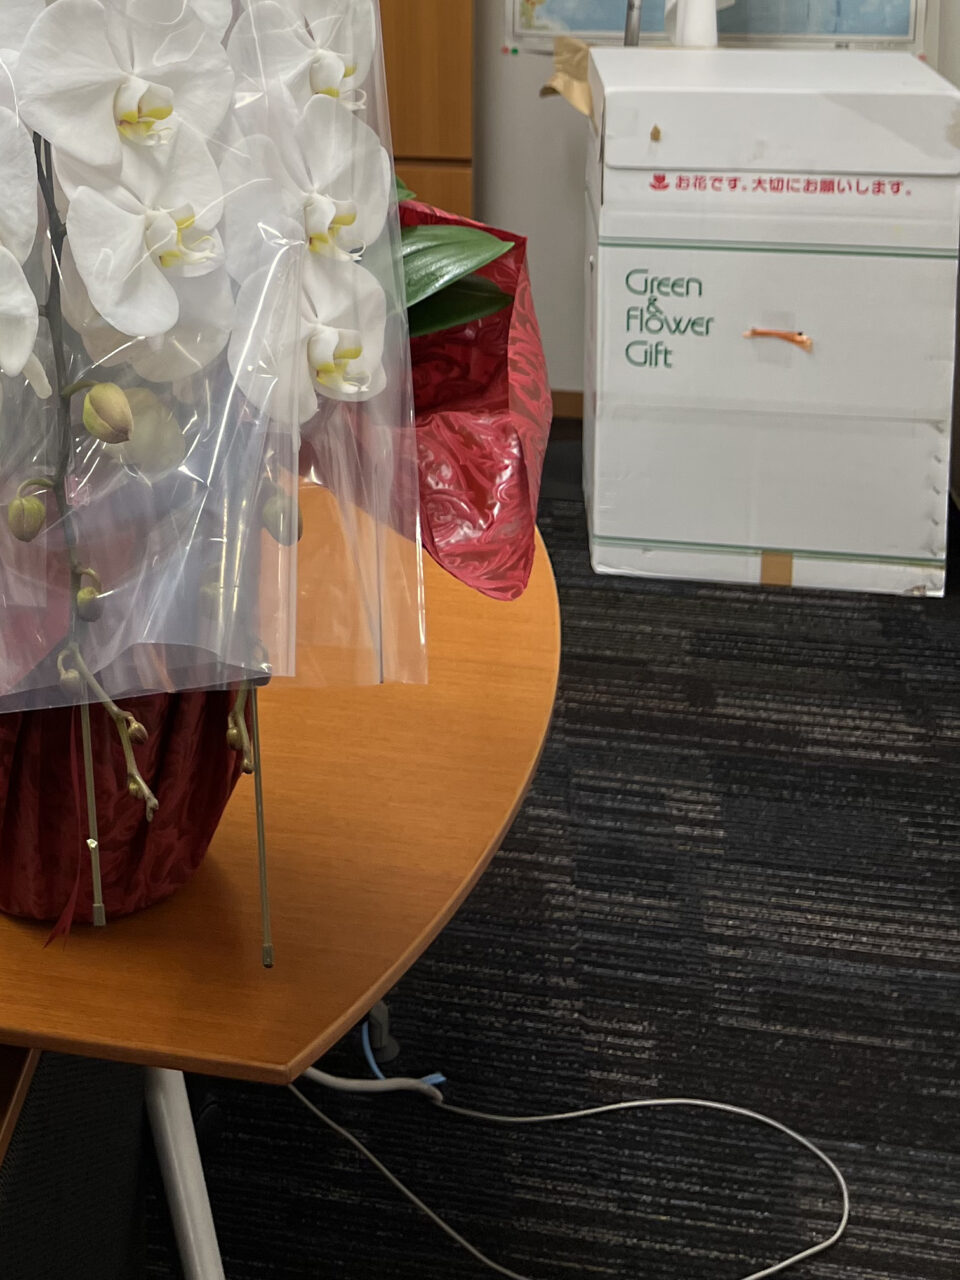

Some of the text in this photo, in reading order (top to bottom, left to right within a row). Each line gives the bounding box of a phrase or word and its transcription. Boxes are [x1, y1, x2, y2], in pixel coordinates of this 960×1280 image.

[625, 268, 703, 297] Green
[646, 295, 663, 316] &
[626, 306, 714, 336] Flower
[625, 340, 672, 368] Gift
